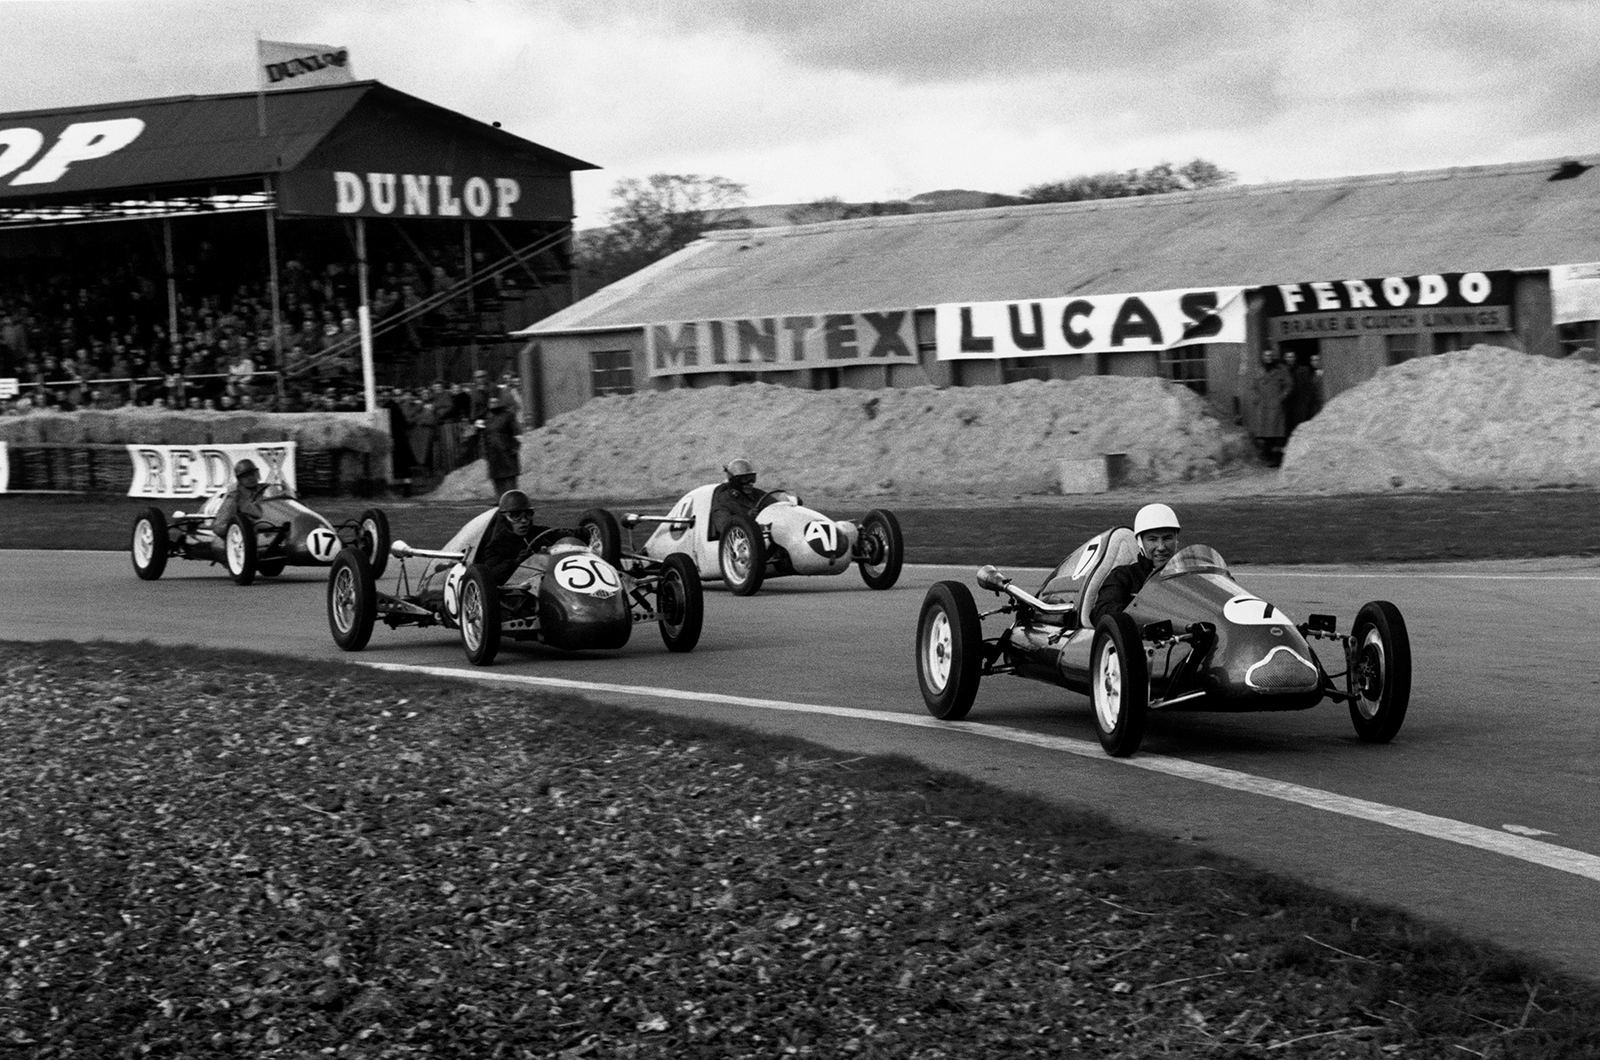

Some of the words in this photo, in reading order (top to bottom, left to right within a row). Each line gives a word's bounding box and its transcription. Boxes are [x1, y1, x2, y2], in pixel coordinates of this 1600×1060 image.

[265, 50, 347, 82] DUNLOP
[333, 171, 521, 217] DUNLOP
[1277, 271, 1491, 312] FERODO
[652, 310, 912, 370] MINTEX
[960, 291, 1223, 352] LUCAS
[139, 447, 286, 494] REDX
[313, 532, 336, 556] 17
[1073, 543, 1100, 579] 7
[561, 559, 619, 588] 50
[446, 573, 462, 620] 5
[1233, 598, 1275, 618] 7
